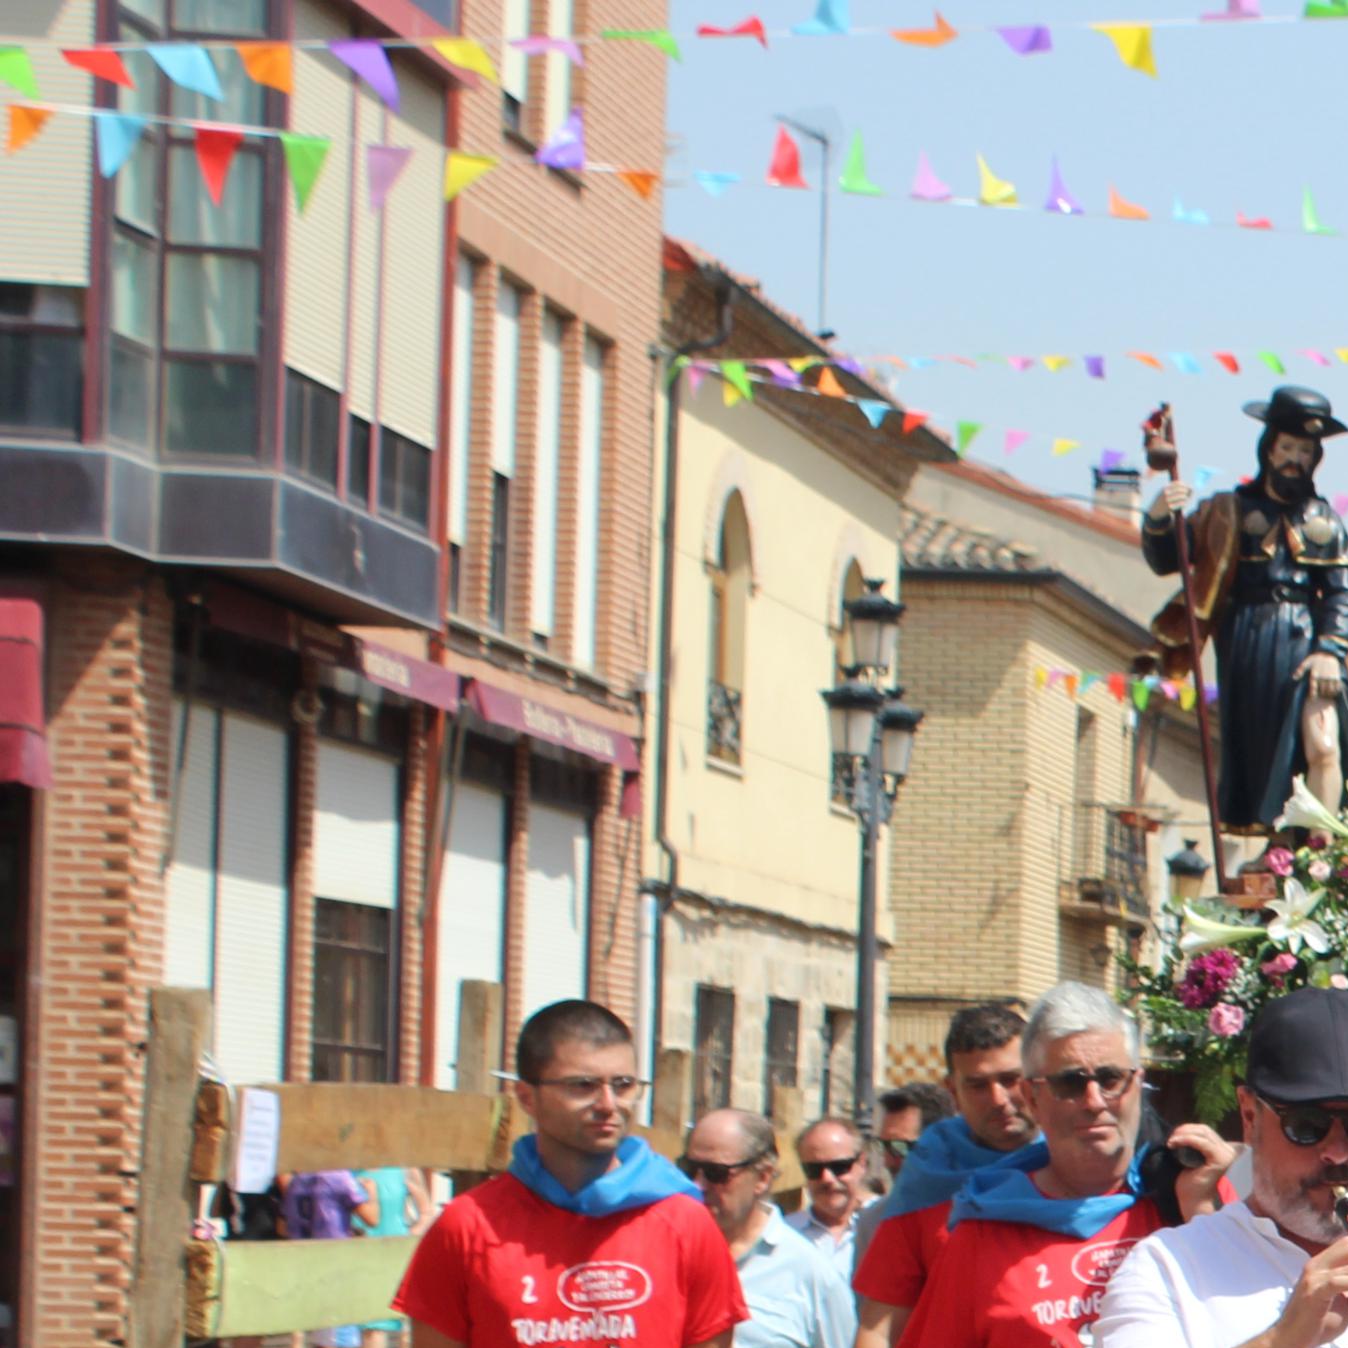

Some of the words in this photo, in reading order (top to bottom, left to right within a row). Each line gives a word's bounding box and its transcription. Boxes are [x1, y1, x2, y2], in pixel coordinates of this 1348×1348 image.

[521, 1275, 538, 1304] 2
[1036, 1263, 1053, 1289] 2
[1031, 1291, 1101, 1325] TORQUE
[511, 1313, 636, 1345] TORQUEMADA
